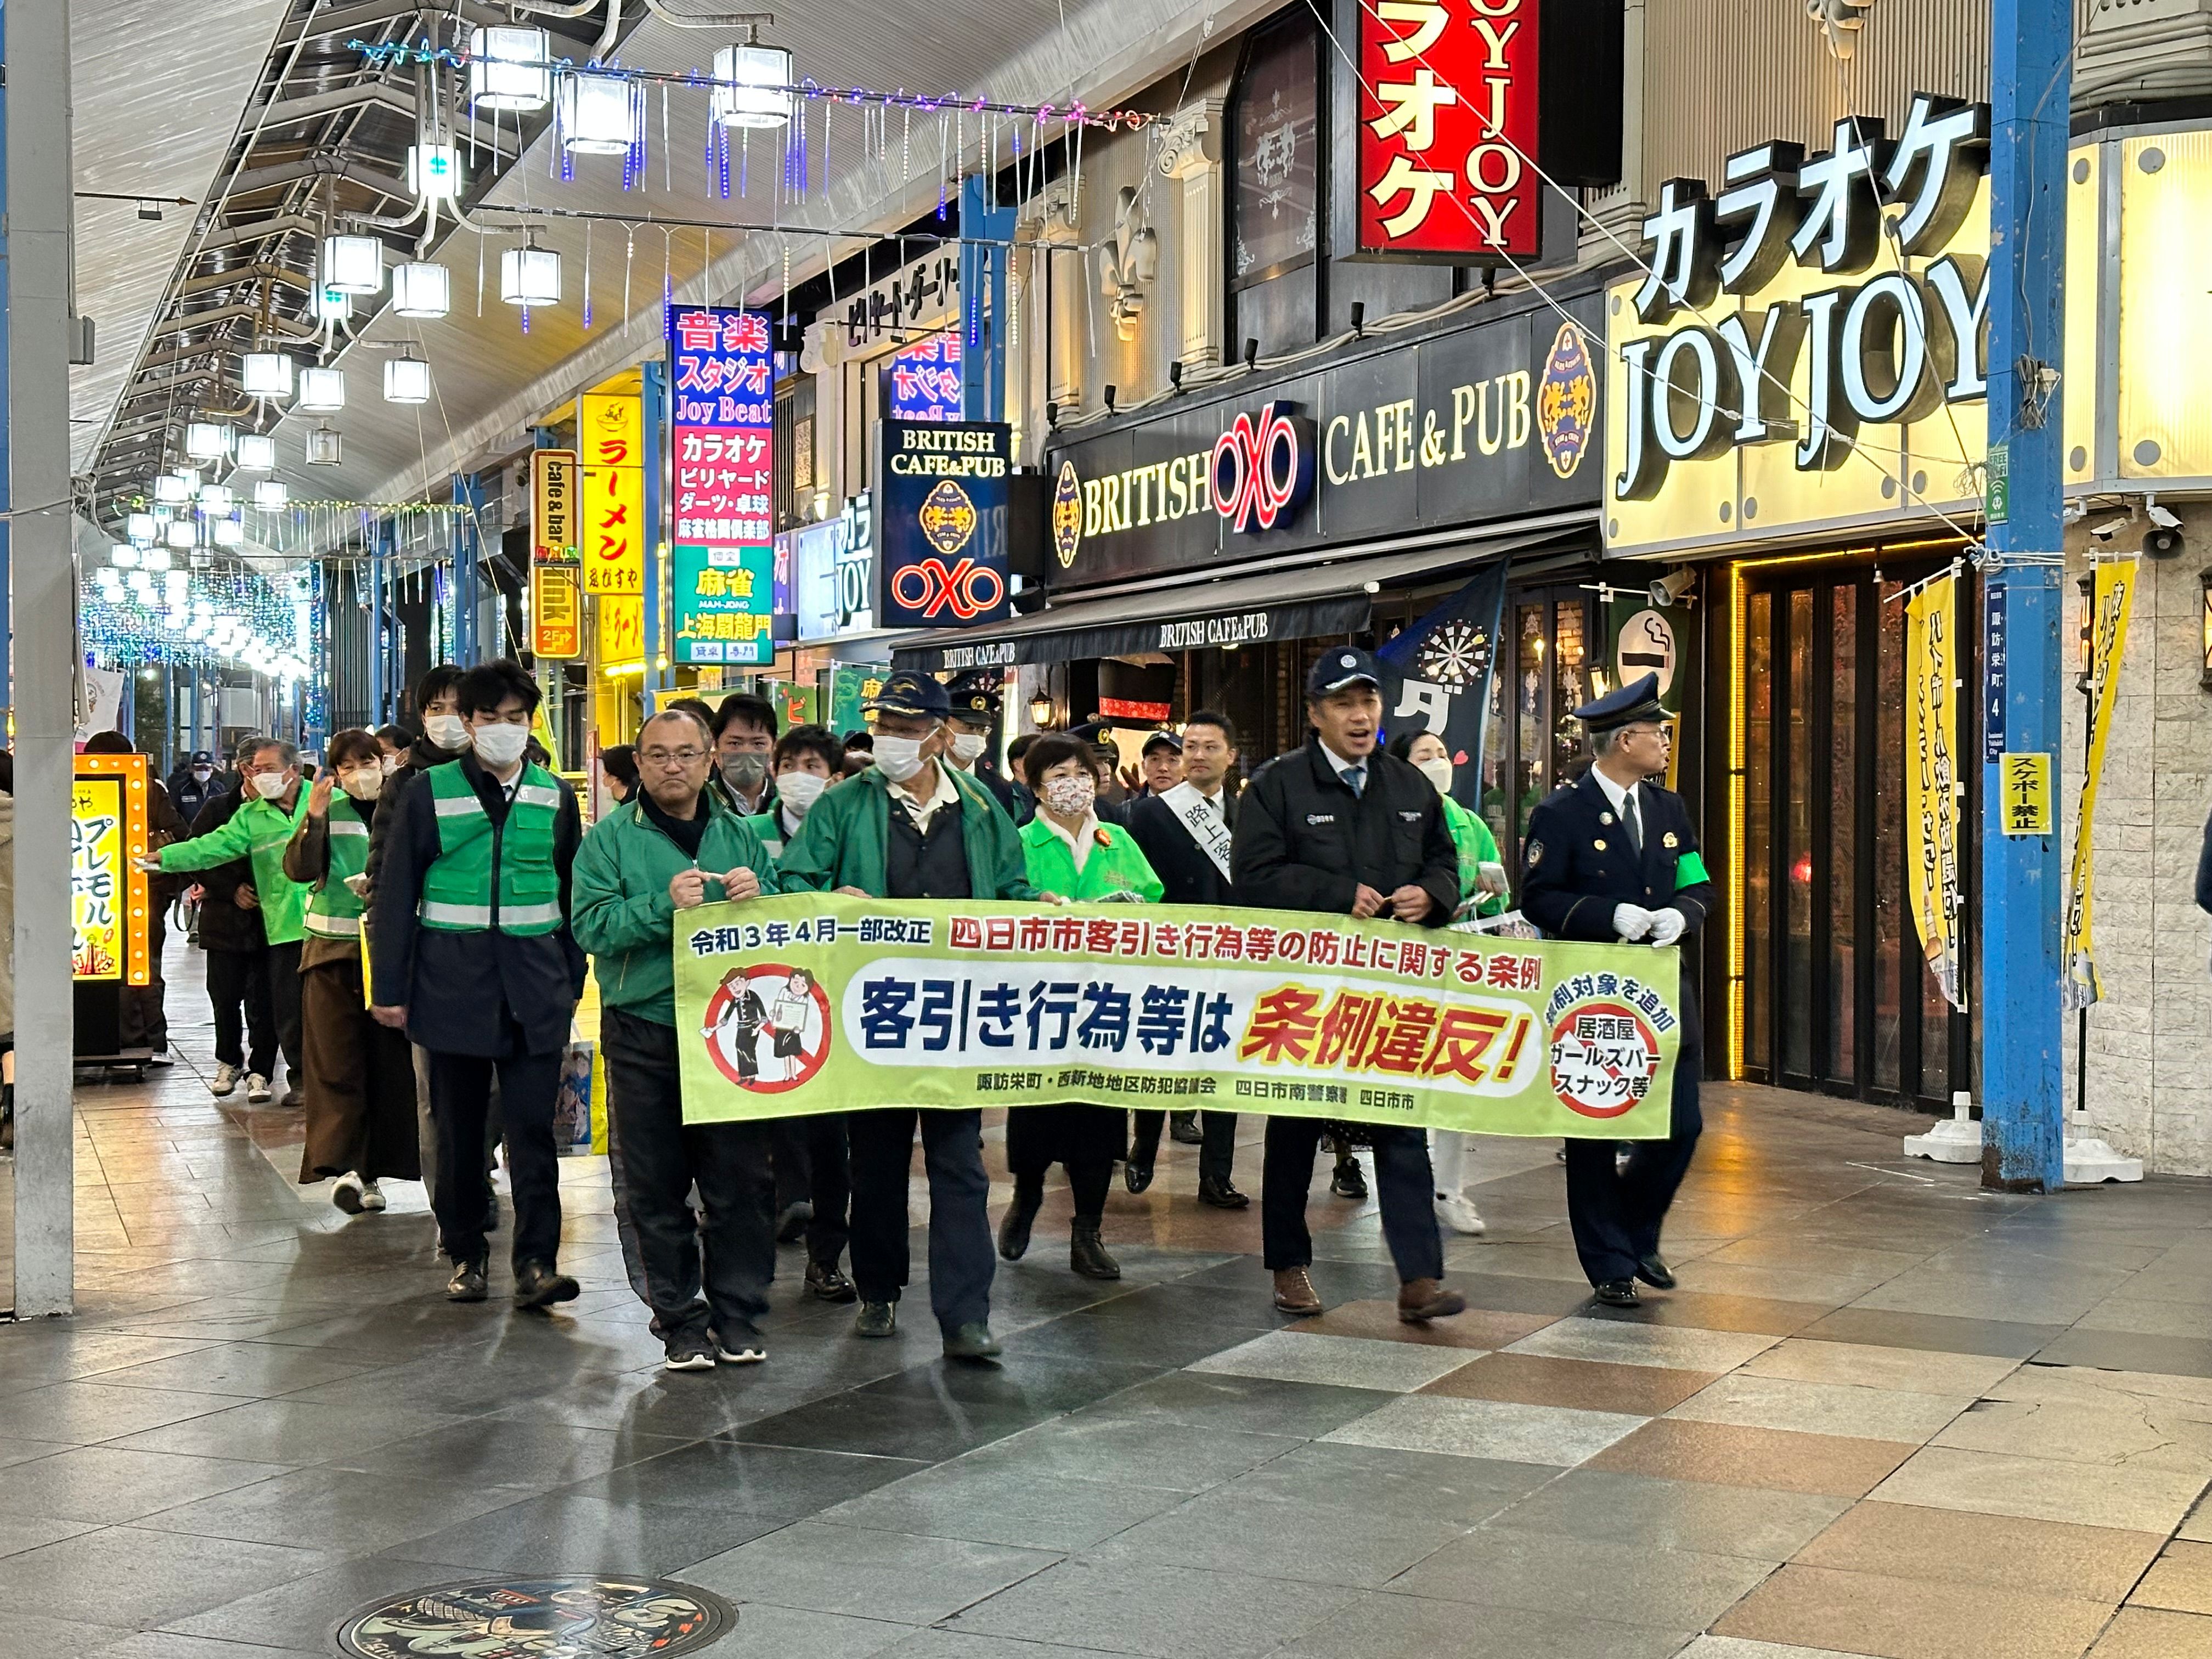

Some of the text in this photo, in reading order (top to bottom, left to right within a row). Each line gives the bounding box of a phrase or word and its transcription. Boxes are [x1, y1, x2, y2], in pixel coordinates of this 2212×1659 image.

[1635, 98, 1974, 315] カラオケ
[676, 311, 769, 353] 音楽
[676, 356, 770, 394] スタジオ
[676, 395, 772, 425] Joy Beat
[682, 433, 766, 464] カラオケ
[902, 430, 996, 452] BRITISH
[548, 461, 565, 498] cafe
[680, 467, 770, 490] ビリヤード
[1084, 450, 1214, 537] BRITISH
[1211, 402, 1298, 534] OXO
[599, 439, 627, 561] ラーメン
[679, 492, 770, 516] ダーツ・卓球
[548, 515, 565, 543] bar
[840, 494, 871, 550] カラ
[695, 567, 755, 598] 麻雀
[835, 558, 872, 626] JOY
[891, 557, 1004, 619] OXO
[698, 600, 750, 610] MAH-JONG
[543, 630, 560, 641] 2F
[676, 612, 772, 641] 上海闘龍門
[1159, 620, 1205, 648] BRITISH
[2011, 758, 2040, 829] スケボー禁止
[84, 817, 114, 926] プレモル
[691, 917, 932, 955] 令和3年4月一部改正
[950, 916, 1541, 990] 四日市市客引き行為等の防止に関する条例
[860, 976, 1233, 1056] 客引き行為等は
[1577, 1016, 1635, 1040] 居酒屋
[1242, 988, 1530, 1082] 条例違反!
[1551, 1043, 1661, 1068] ガールズバー
[1360, 1088, 1414, 1110] 四日市市
[1556, 1074, 1649, 1097] スナック等
